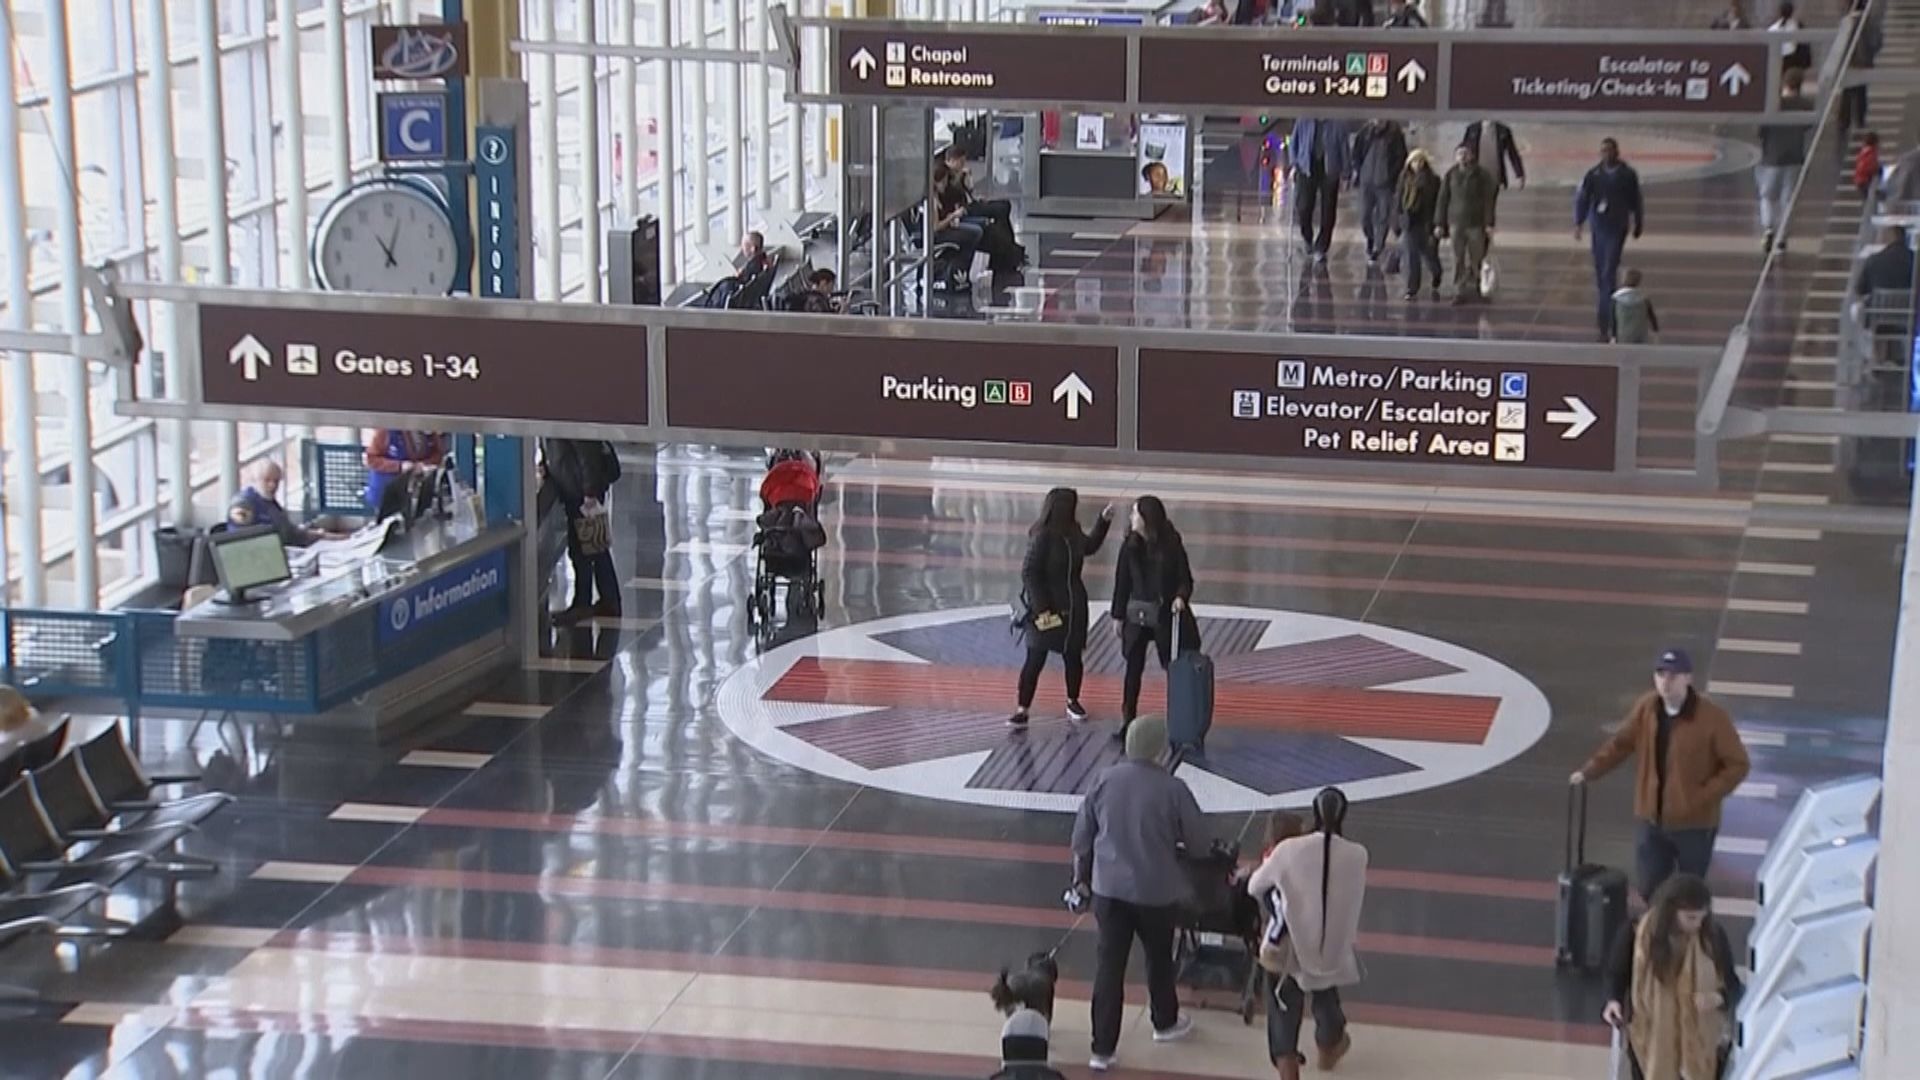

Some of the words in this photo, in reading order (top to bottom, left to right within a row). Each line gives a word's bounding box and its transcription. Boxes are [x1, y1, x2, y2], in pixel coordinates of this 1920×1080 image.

[911, 46, 967, 65] Chapel
[1262, 54, 1340, 73] Terminals
[1600, 56, 1682, 74] Escalator
[1690, 58, 1710, 74] to
[911, 68, 994, 86] Restrooms
[1266, 77, 1316, 94] Gates
[1324, 77, 1361, 94] 1-34
[1512, 78, 1682, 99] Ticketing/Check-In
[400, 110, 431, 152] C
[335, 350, 413, 376] Gates
[423, 354, 480, 379] 1-34
[882, 375, 977, 407] Parking
[1282, 364, 1300, 381] M
[1312, 366, 1492, 396] Metro/Parking
[1504, 377, 1522, 395] C
[1267, 396, 1491, 425] Elevator/Escalator
[1304, 428, 1341, 449] Pet
[1351, 430, 1419, 453] Relief
[1429, 440, 1490, 456] Area
[415, 568, 498, 620] Information
